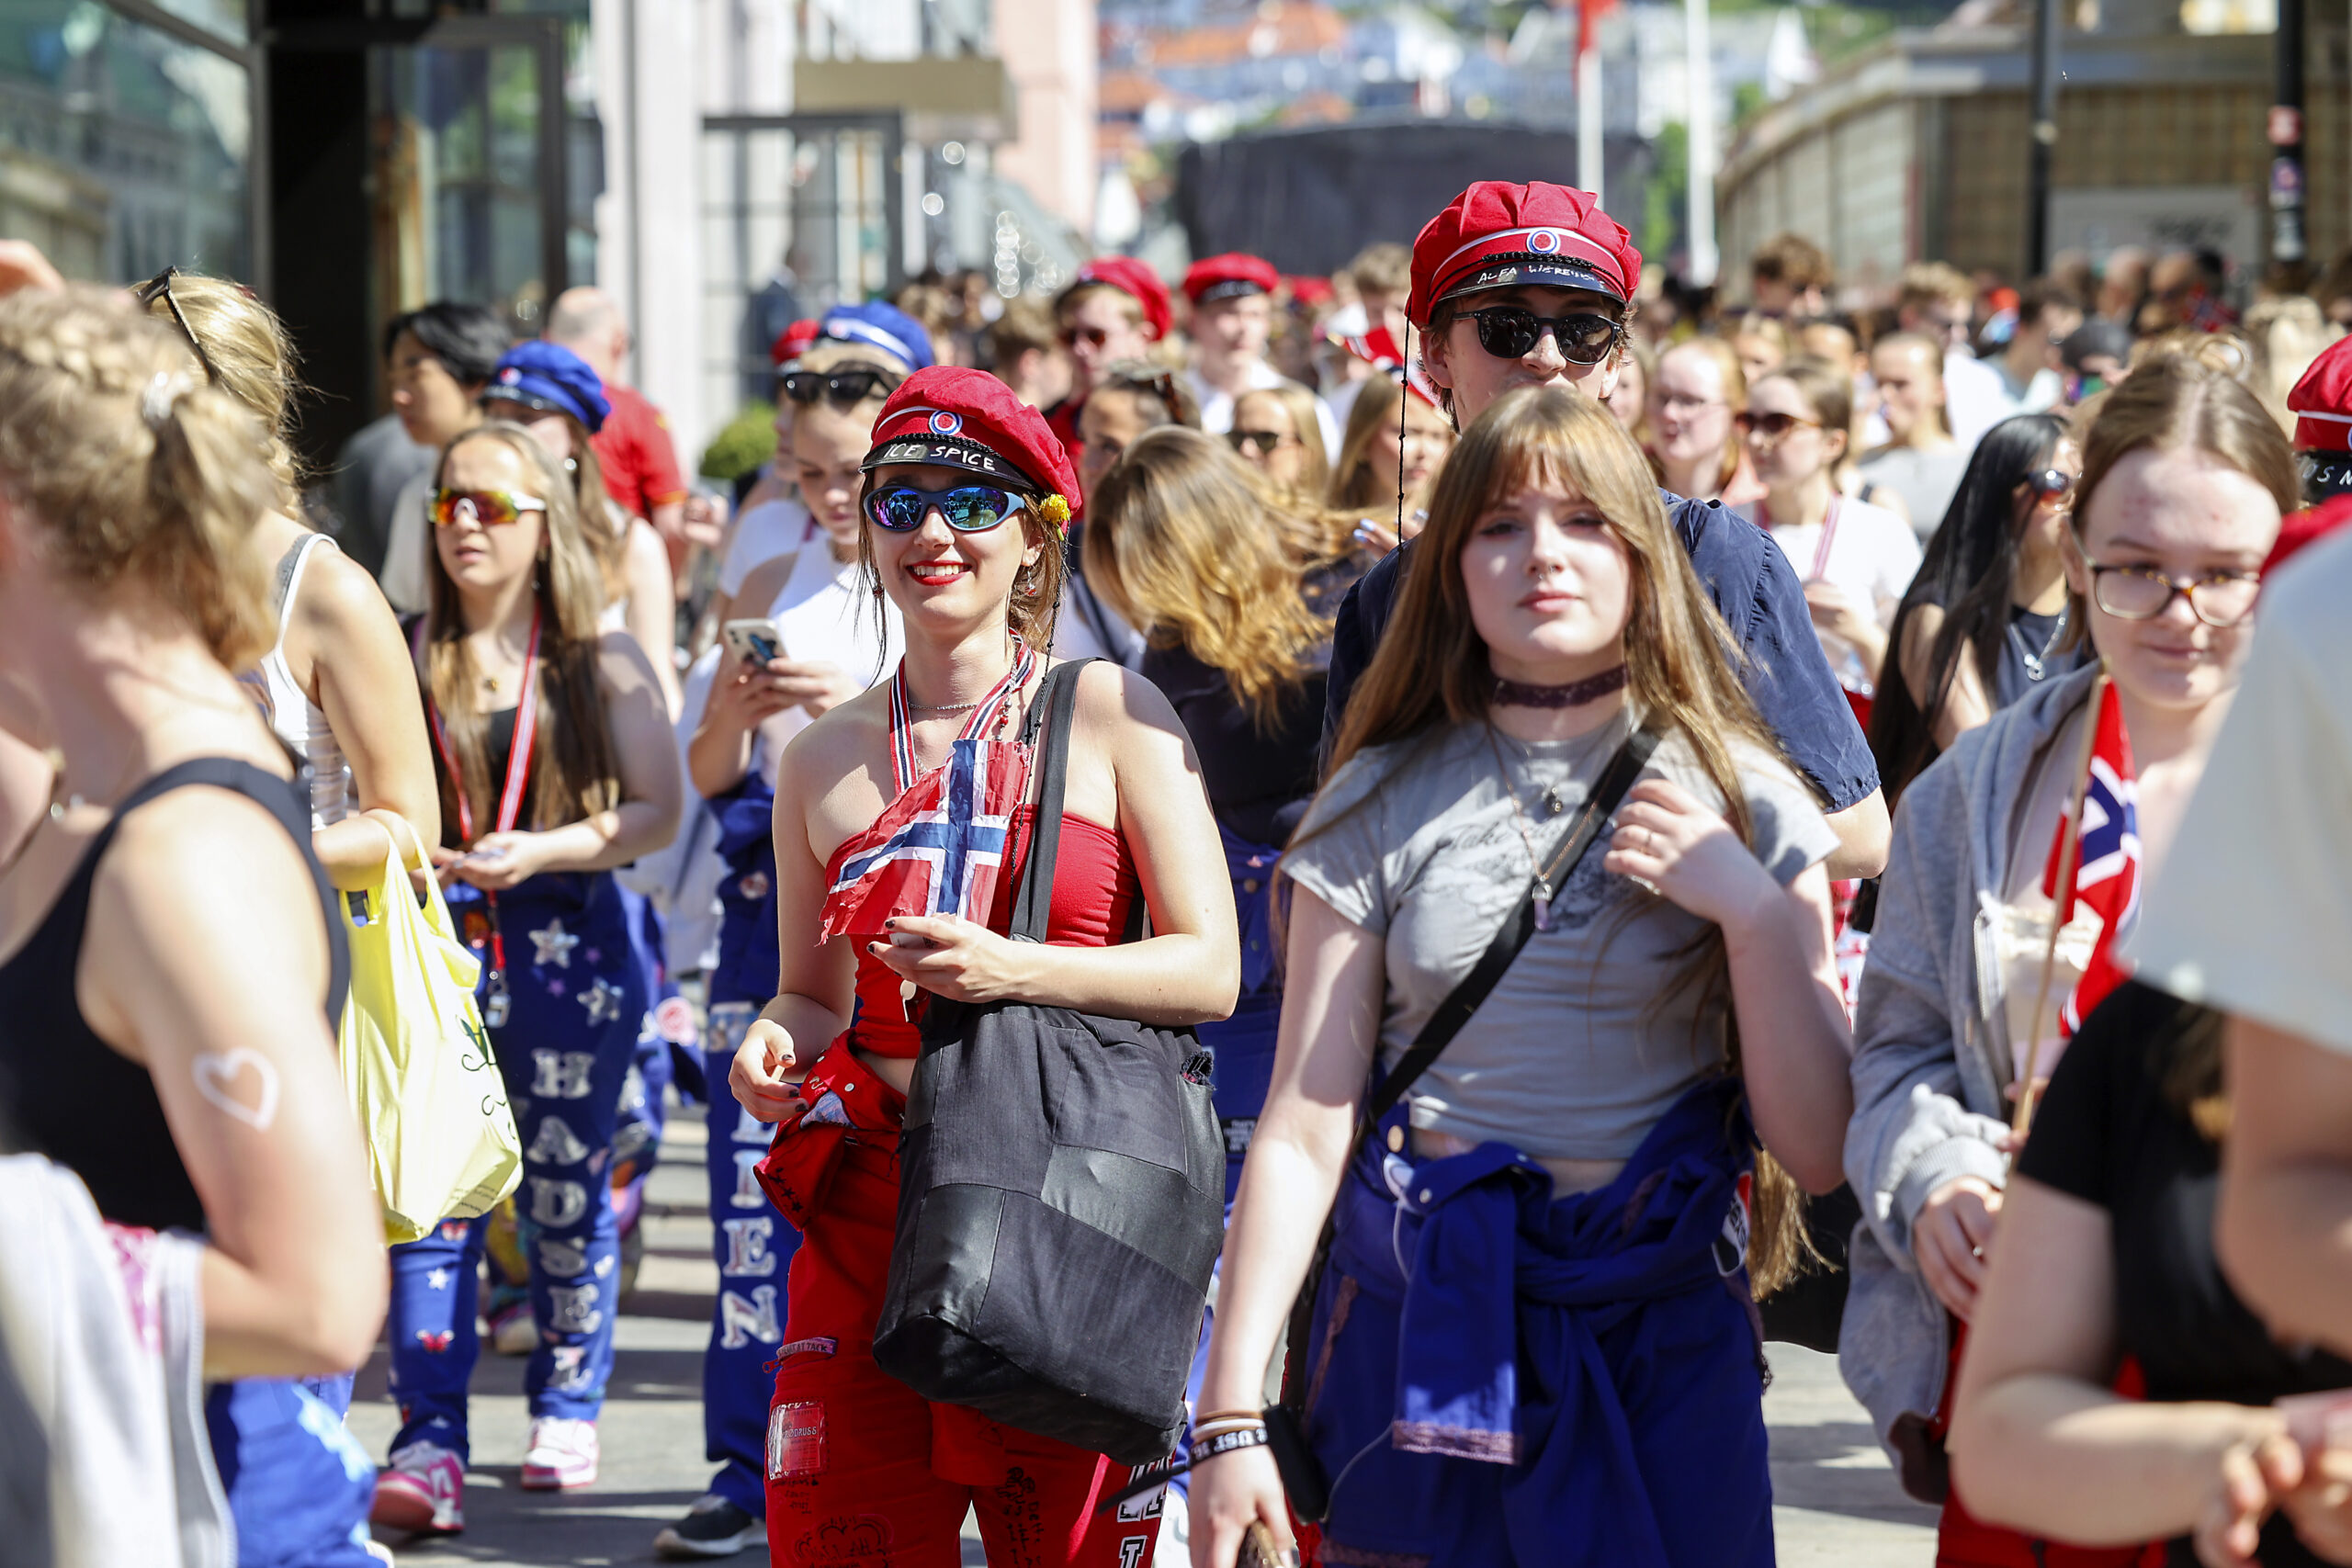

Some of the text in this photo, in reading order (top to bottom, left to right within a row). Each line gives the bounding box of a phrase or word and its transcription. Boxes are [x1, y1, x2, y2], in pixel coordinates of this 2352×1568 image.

[1477, 266, 1517, 285] ALFA
[884, 443, 996, 471] ICE SPICE
